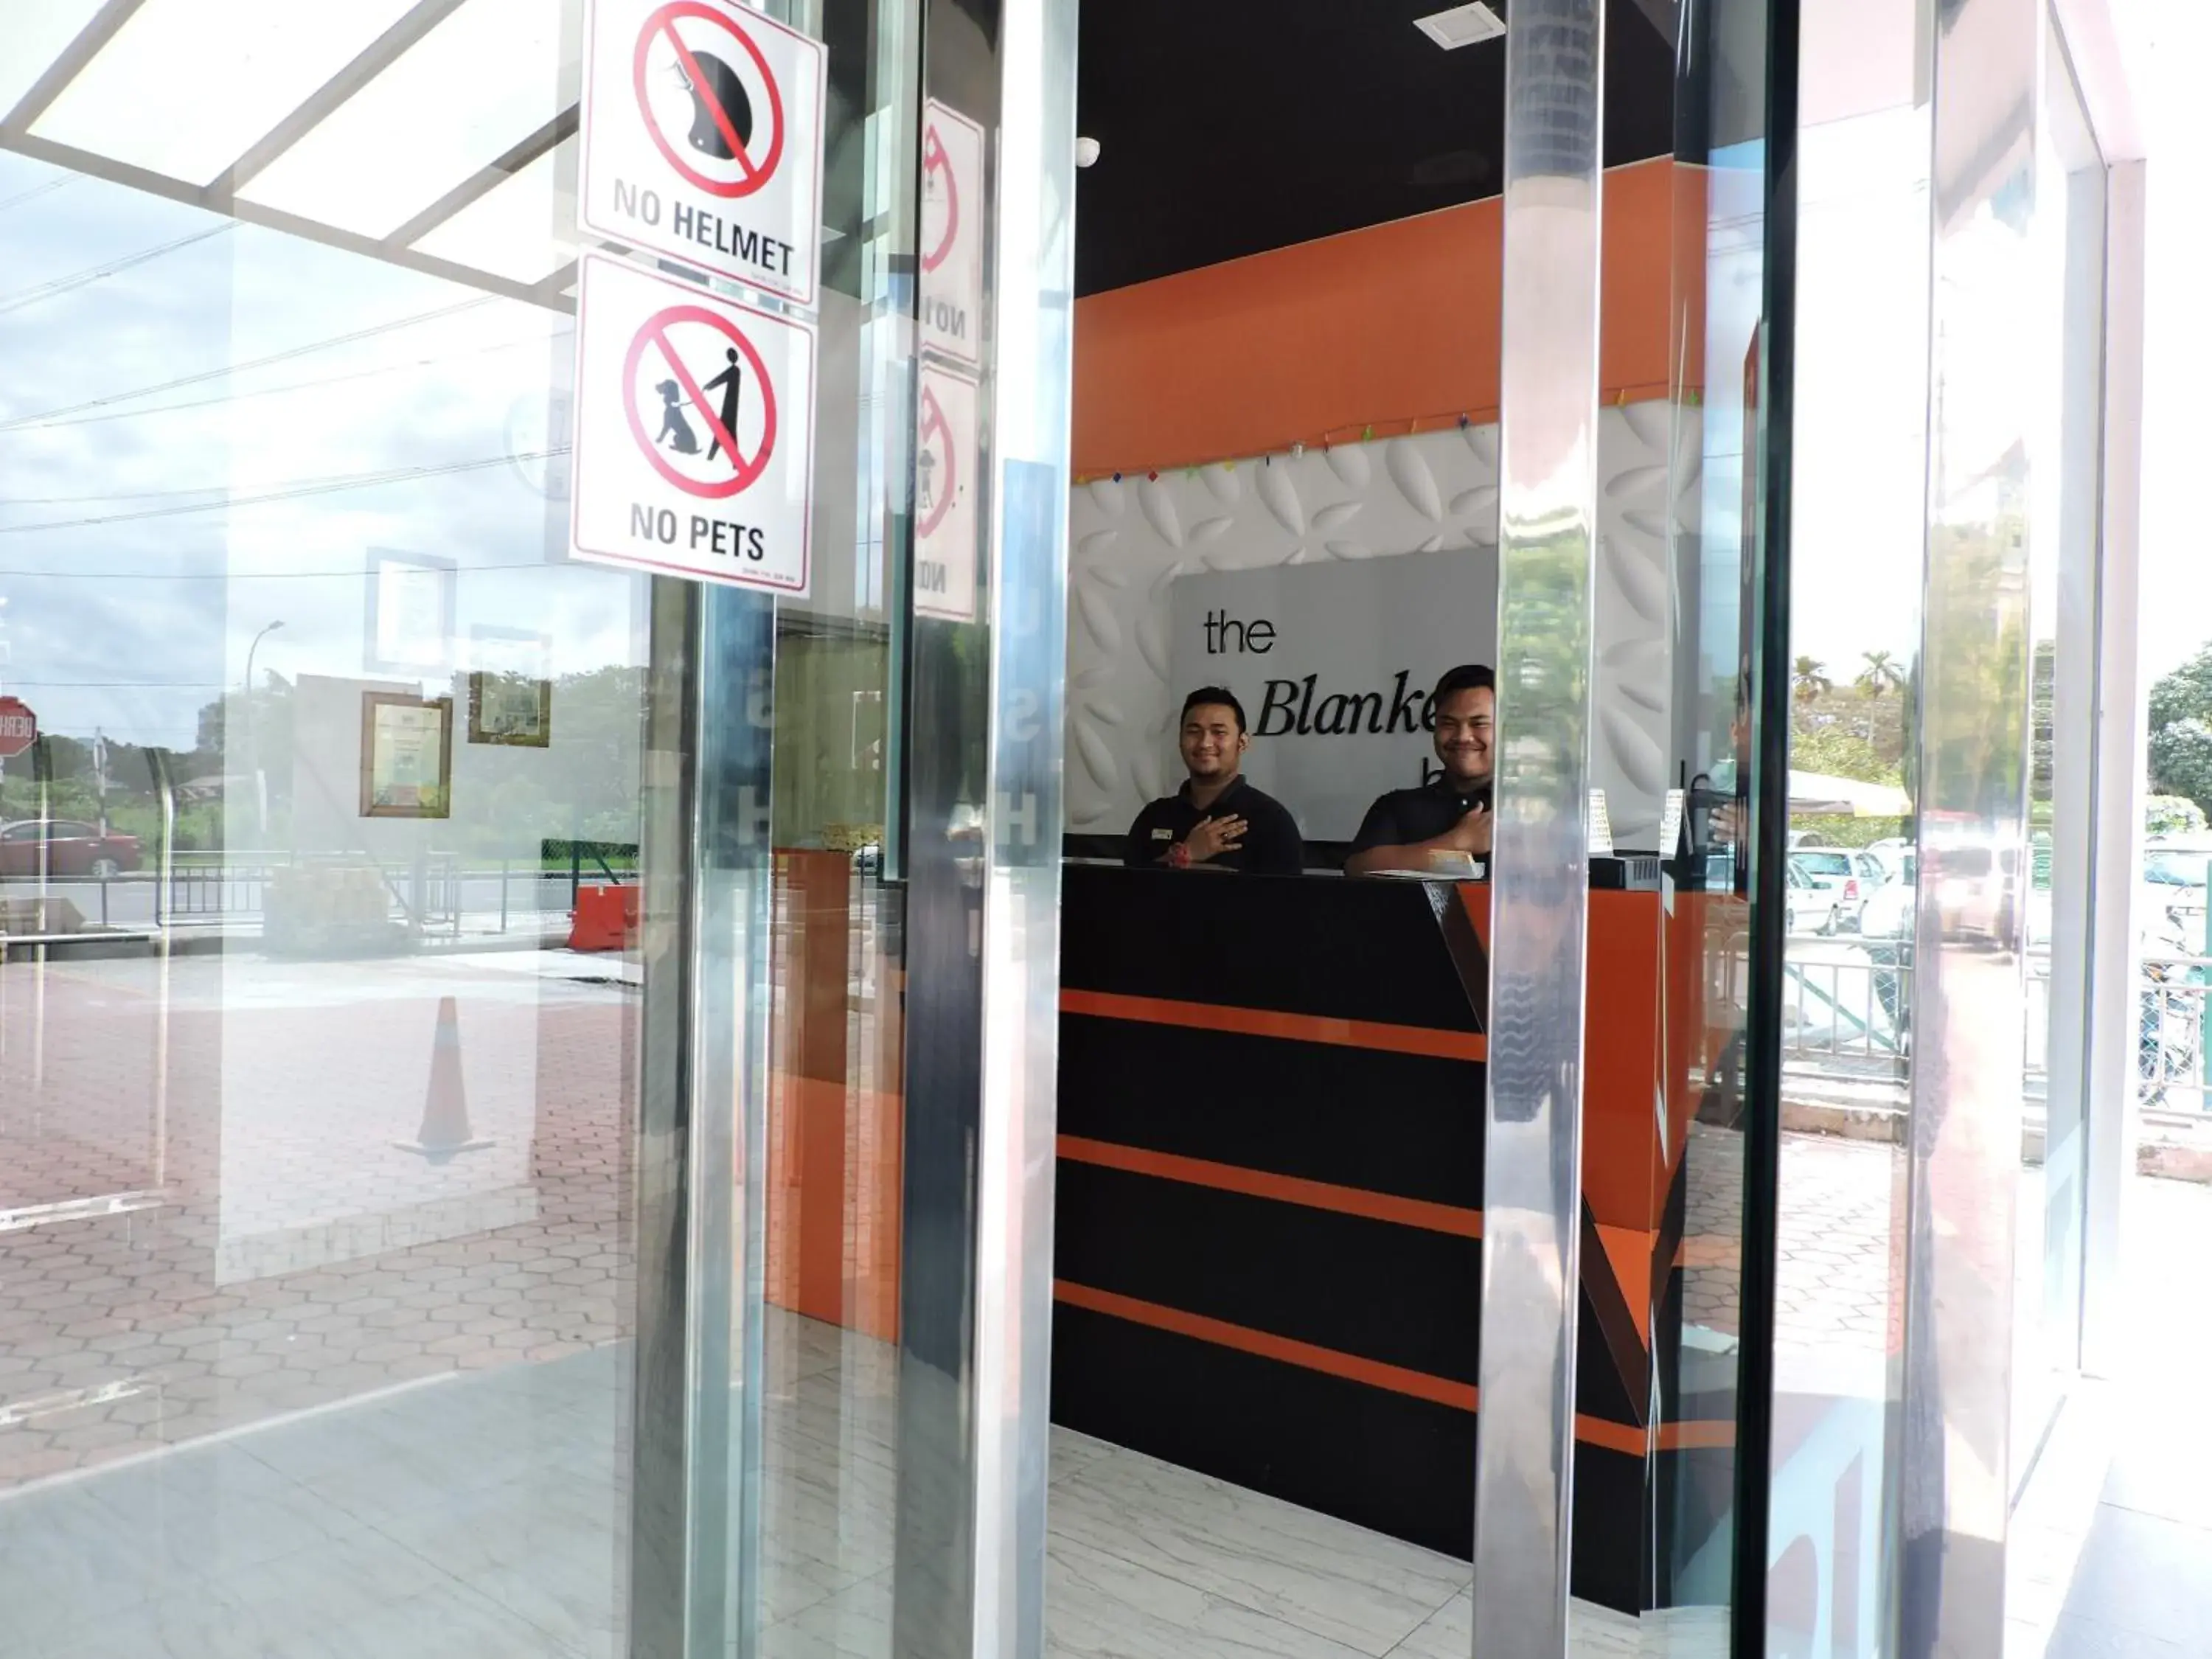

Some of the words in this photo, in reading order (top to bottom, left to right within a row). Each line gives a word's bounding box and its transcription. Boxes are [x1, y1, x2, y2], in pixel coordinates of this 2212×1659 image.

[613, 178, 661, 226] NO
[673, 202, 794, 276] HELMET
[630, 503, 678, 545] NO
[689, 515, 765, 561] PETS
[1203, 609, 1276, 654] the
